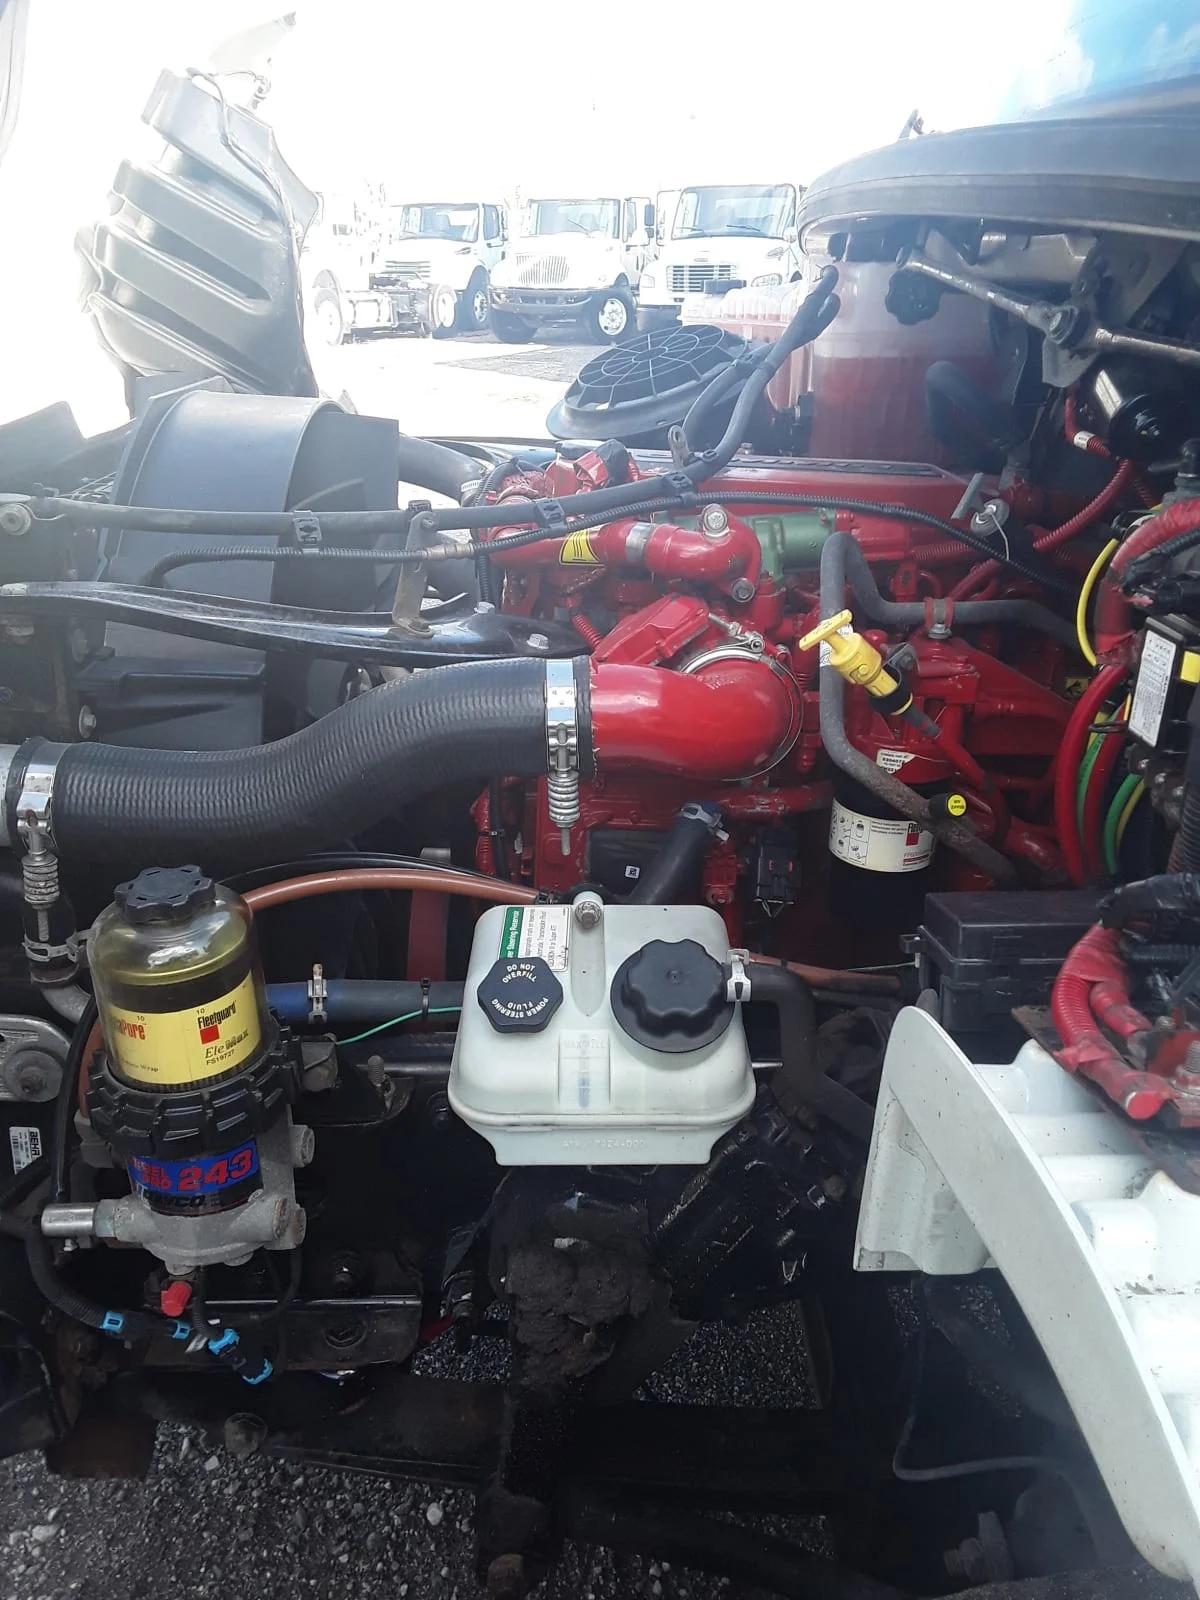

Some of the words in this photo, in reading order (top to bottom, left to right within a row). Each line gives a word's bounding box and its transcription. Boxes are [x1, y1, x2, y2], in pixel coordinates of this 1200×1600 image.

[502, 971, 537, 984] OVERFILL
[506, 964, 518, 972] DO
[520, 963, 536, 972] NOT
[196, 1007, 206, 1015] 10
[198, 1001, 237, 1029] Fleetguard
[491, 998, 525, 1018] STEERING
[507, 1001, 534, 1011] FLUID
[526, 997, 549, 1017] POWER
[30, 1131, 40, 1156] BEHR
[177, 1148, 253, 1192] 243
